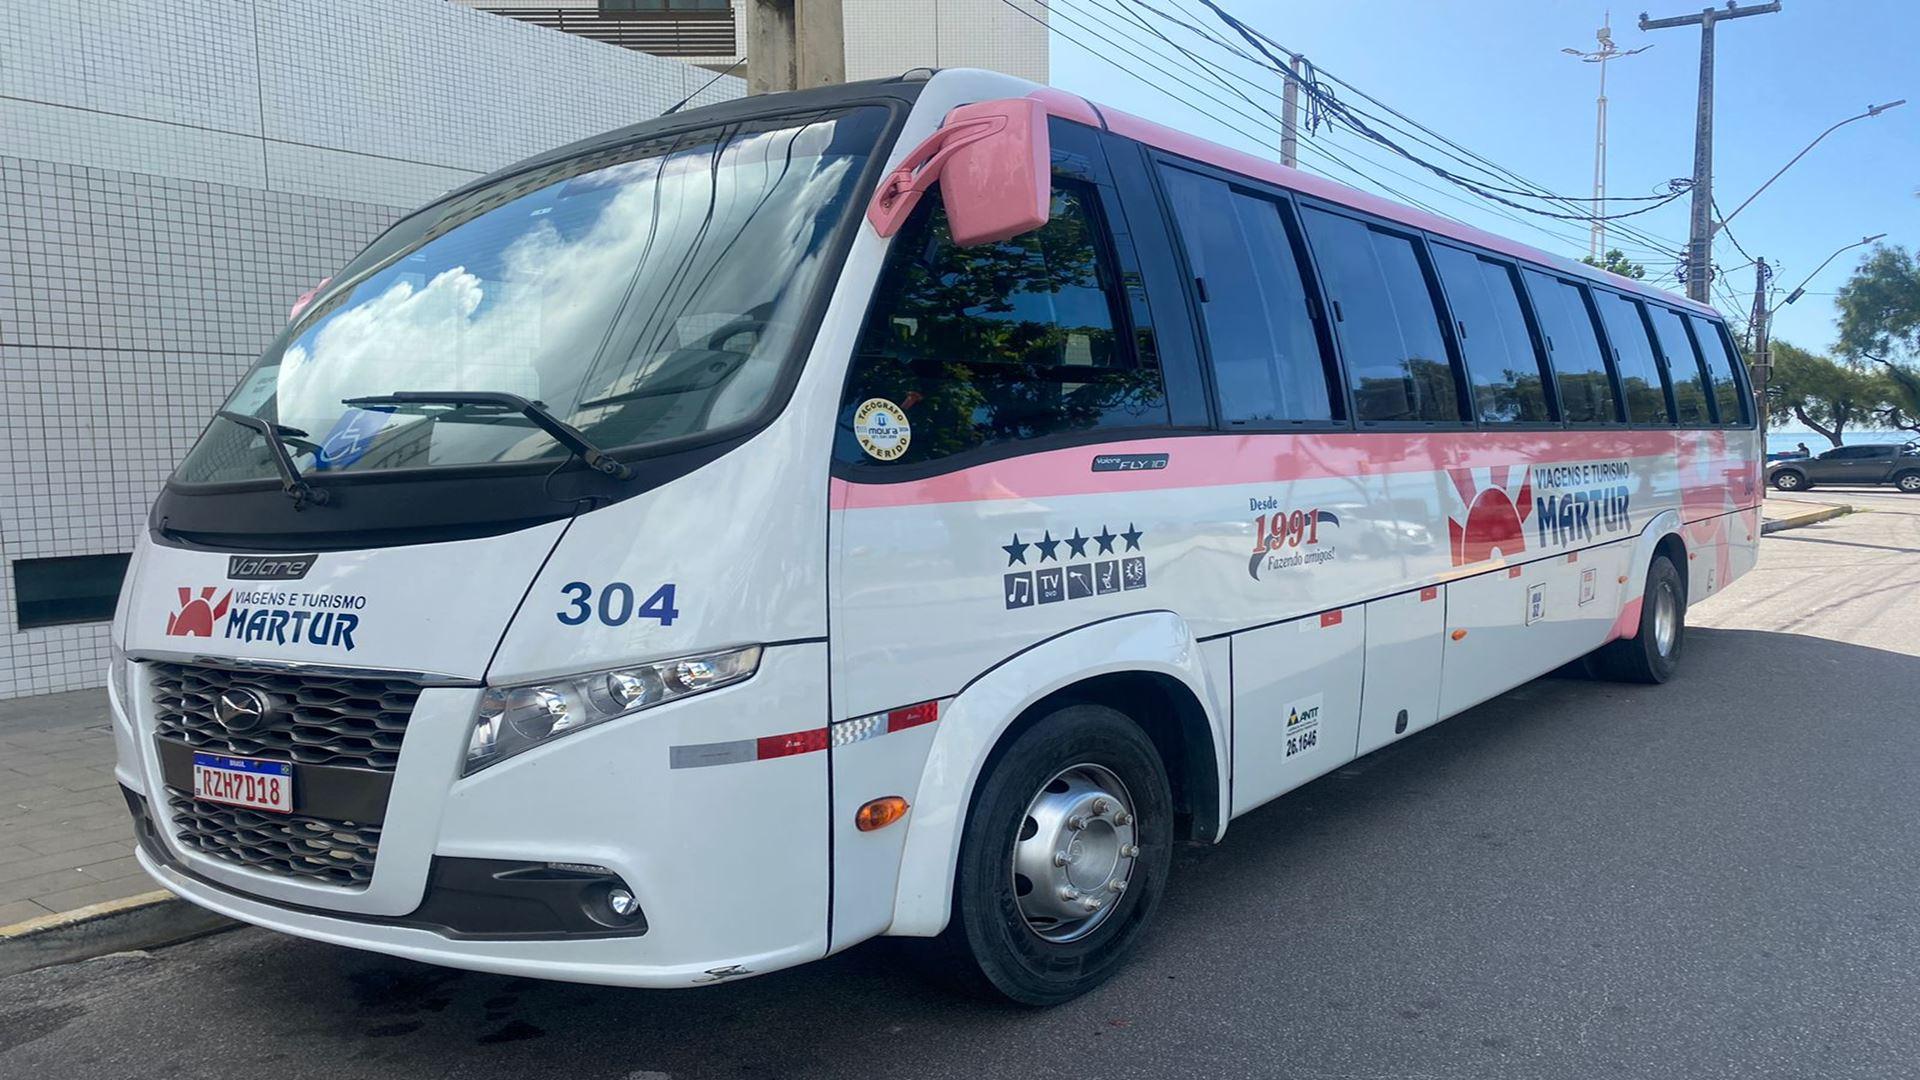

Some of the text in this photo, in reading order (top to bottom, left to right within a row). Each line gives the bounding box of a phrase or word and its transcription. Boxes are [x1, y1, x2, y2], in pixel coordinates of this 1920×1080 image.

[868, 427, 898, 435] moura
[862, 437, 907, 458] AFERIDO
[1119, 460, 1149, 470] FLY
[1151, 459, 1167, 469] 10
[1535, 461, 1630, 489] VIAGENS E TURISMO
[1249, 496, 1278, 511] Desde
[1537, 485, 1632, 548] MARTUR
[1253, 508, 1318, 552] 1991
[230, 557, 307, 575] Volare
[1268, 546, 1335, 571] Fazendo amigos!
[1040, 574, 1059, 590] TV
[235, 591, 366, 610] VIAGENS E TURISMO
[556, 581, 679, 627] 304
[225, 608, 359, 651] MARTUR
[1300, 706, 1319, 721] ANTT
[203, 769, 280, 805] RZH7D18
